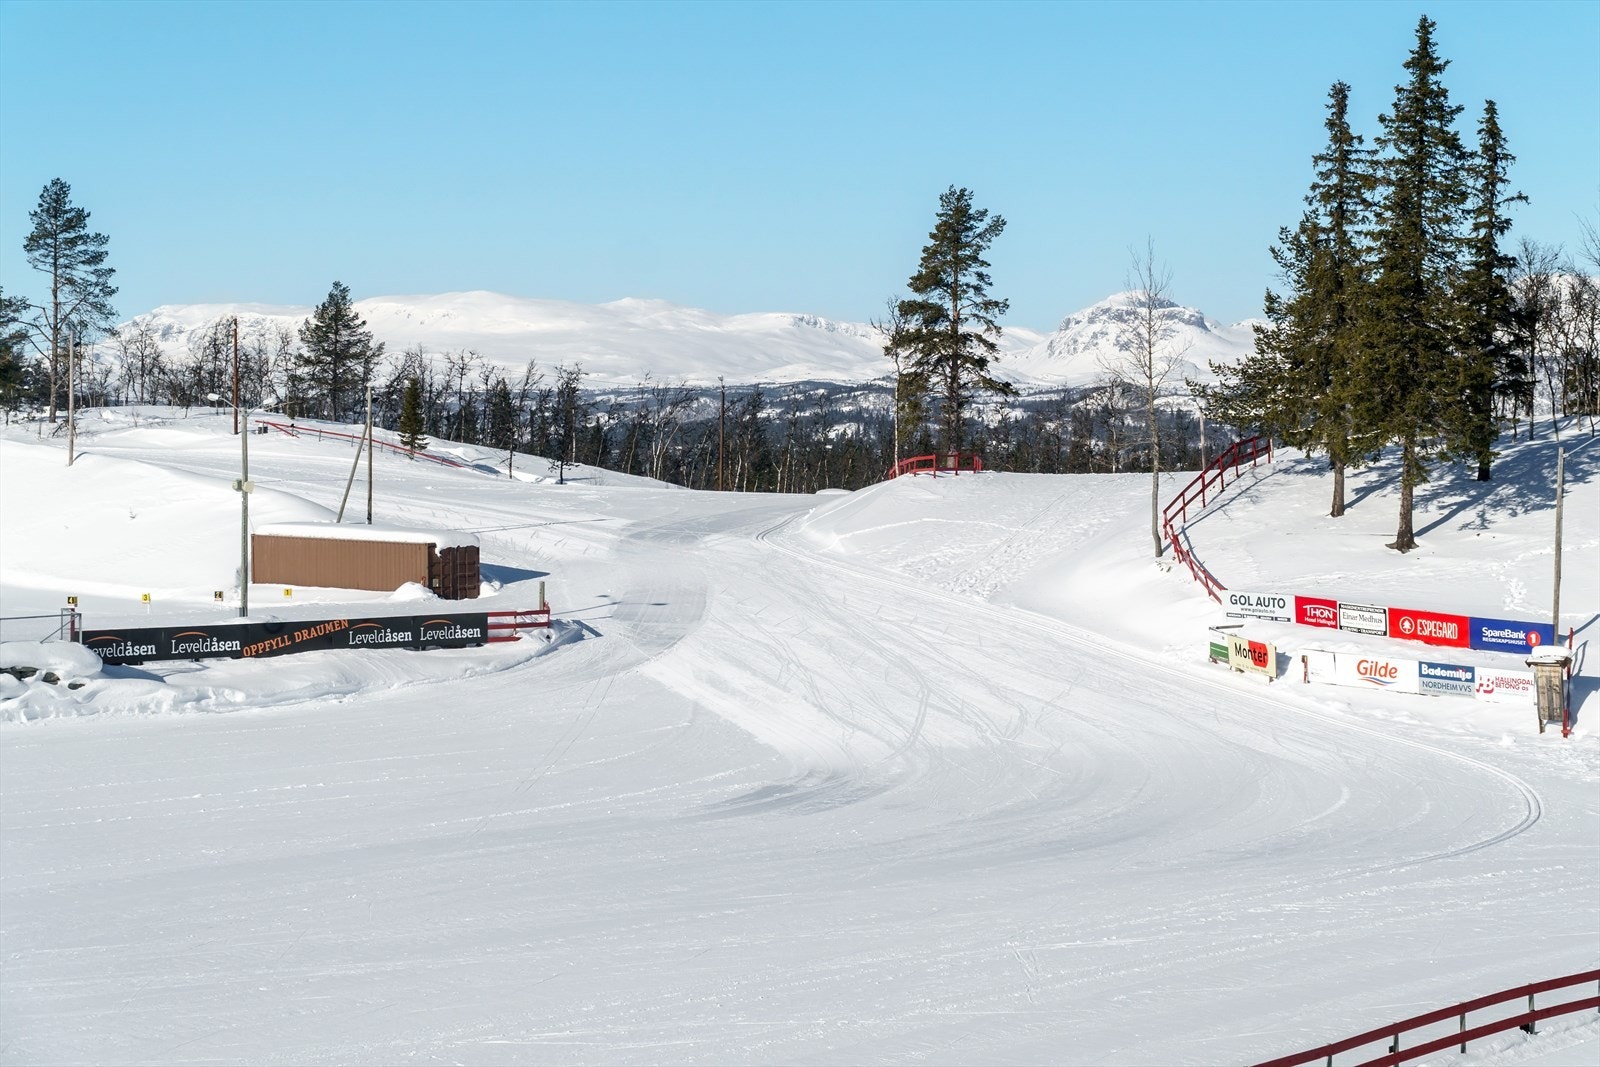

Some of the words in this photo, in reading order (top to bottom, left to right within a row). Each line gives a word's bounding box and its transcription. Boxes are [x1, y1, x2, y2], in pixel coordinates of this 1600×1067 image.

[1230, 594, 1253, 606] GOL
[1256, 596, 1286, 609] AUTO
[1303, 605, 1333, 619] THON
[1343, 612, 1357, 620] Einar
[1358, 614, 1383, 624] Medhus
[349, 627, 413, 645] Leveldåsen
[420, 624, 481, 641] Leveldåsen
[1417, 618, 1459, 640] ESPEGARD
[1482, 627, 1526, 639] SpareBank
[1530, 633, 1537, 644] 1
[171, 637, 241, 654] Leveldåsen
[242, 634, 292, 657] OPPFYLL
[294, 619, 349, 643] DRAUMEN
[85, 641, 157, 658] eveldåsen
[1357, 659, 1398, 679] Gilde
[1421, 663, 1472, 681] Bademiljø
[1422, 681, 1459, 690] NORDHEIM
[1495, 676, 1534, 686] HALLINGDAL
[1495, 682, 1520, 690] BETONG
